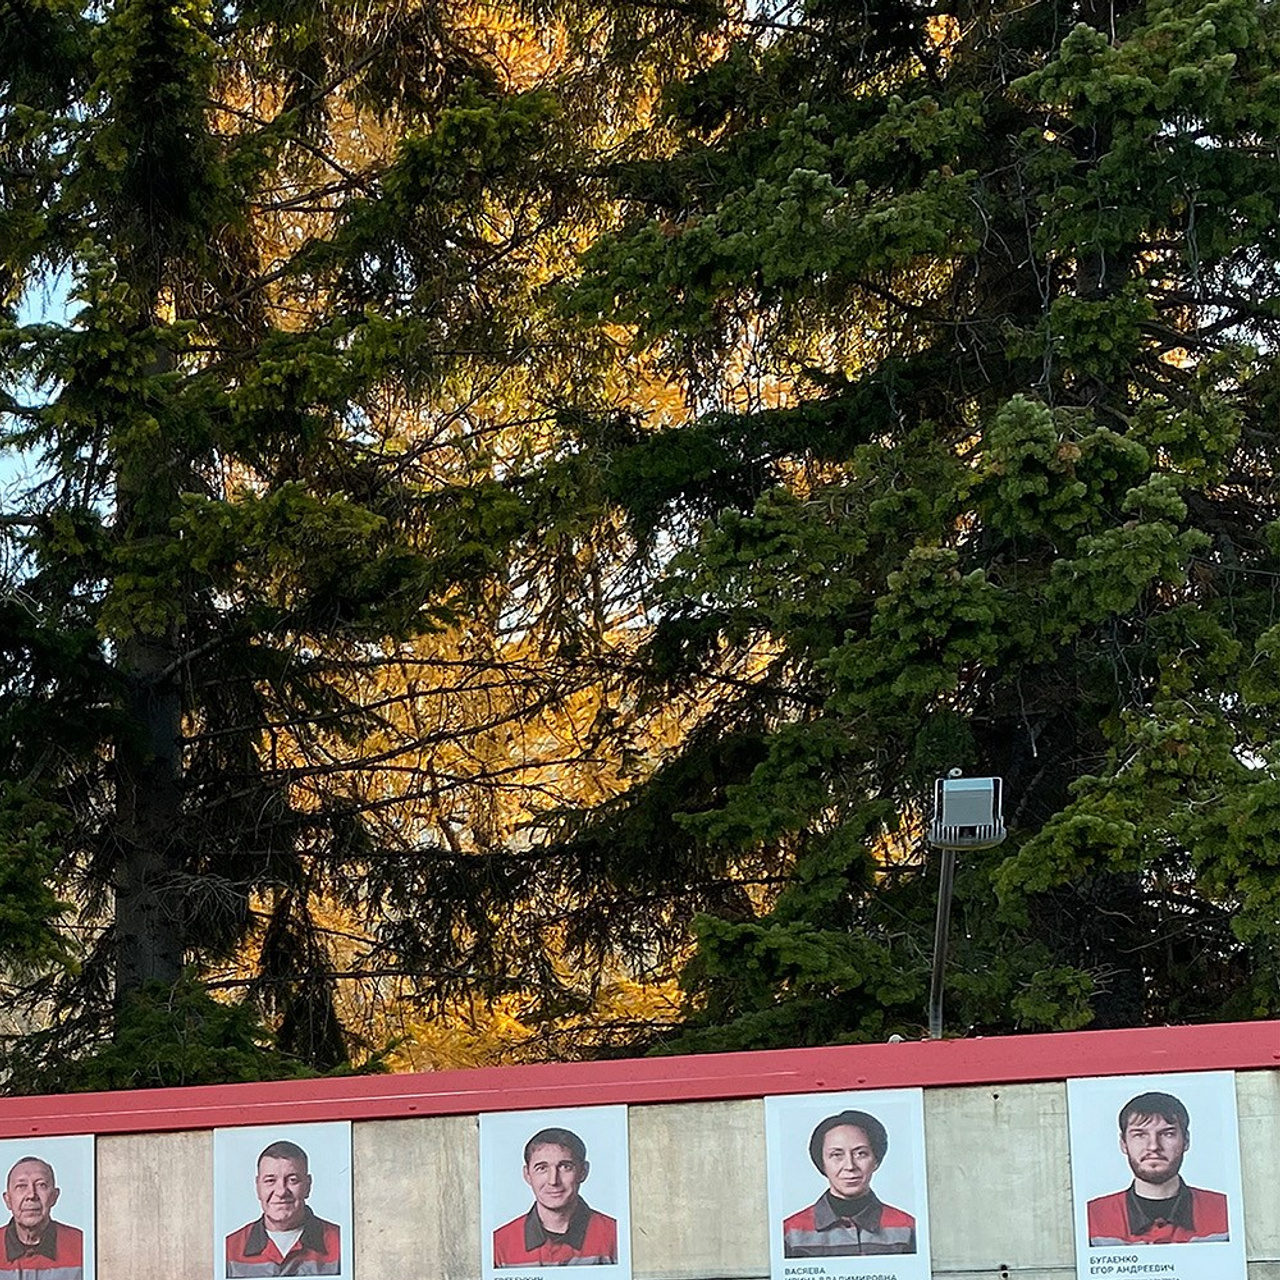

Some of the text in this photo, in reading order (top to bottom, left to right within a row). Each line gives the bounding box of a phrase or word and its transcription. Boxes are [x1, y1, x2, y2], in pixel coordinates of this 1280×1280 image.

[1090, 1255, 1139, 1264] БУГАЕНКО
[785, 1266, 825, 1275] ВАСЯЕВА
[1090, 1264, 1175, 1274] ЕГОР АНДРЕЕВИЧ
